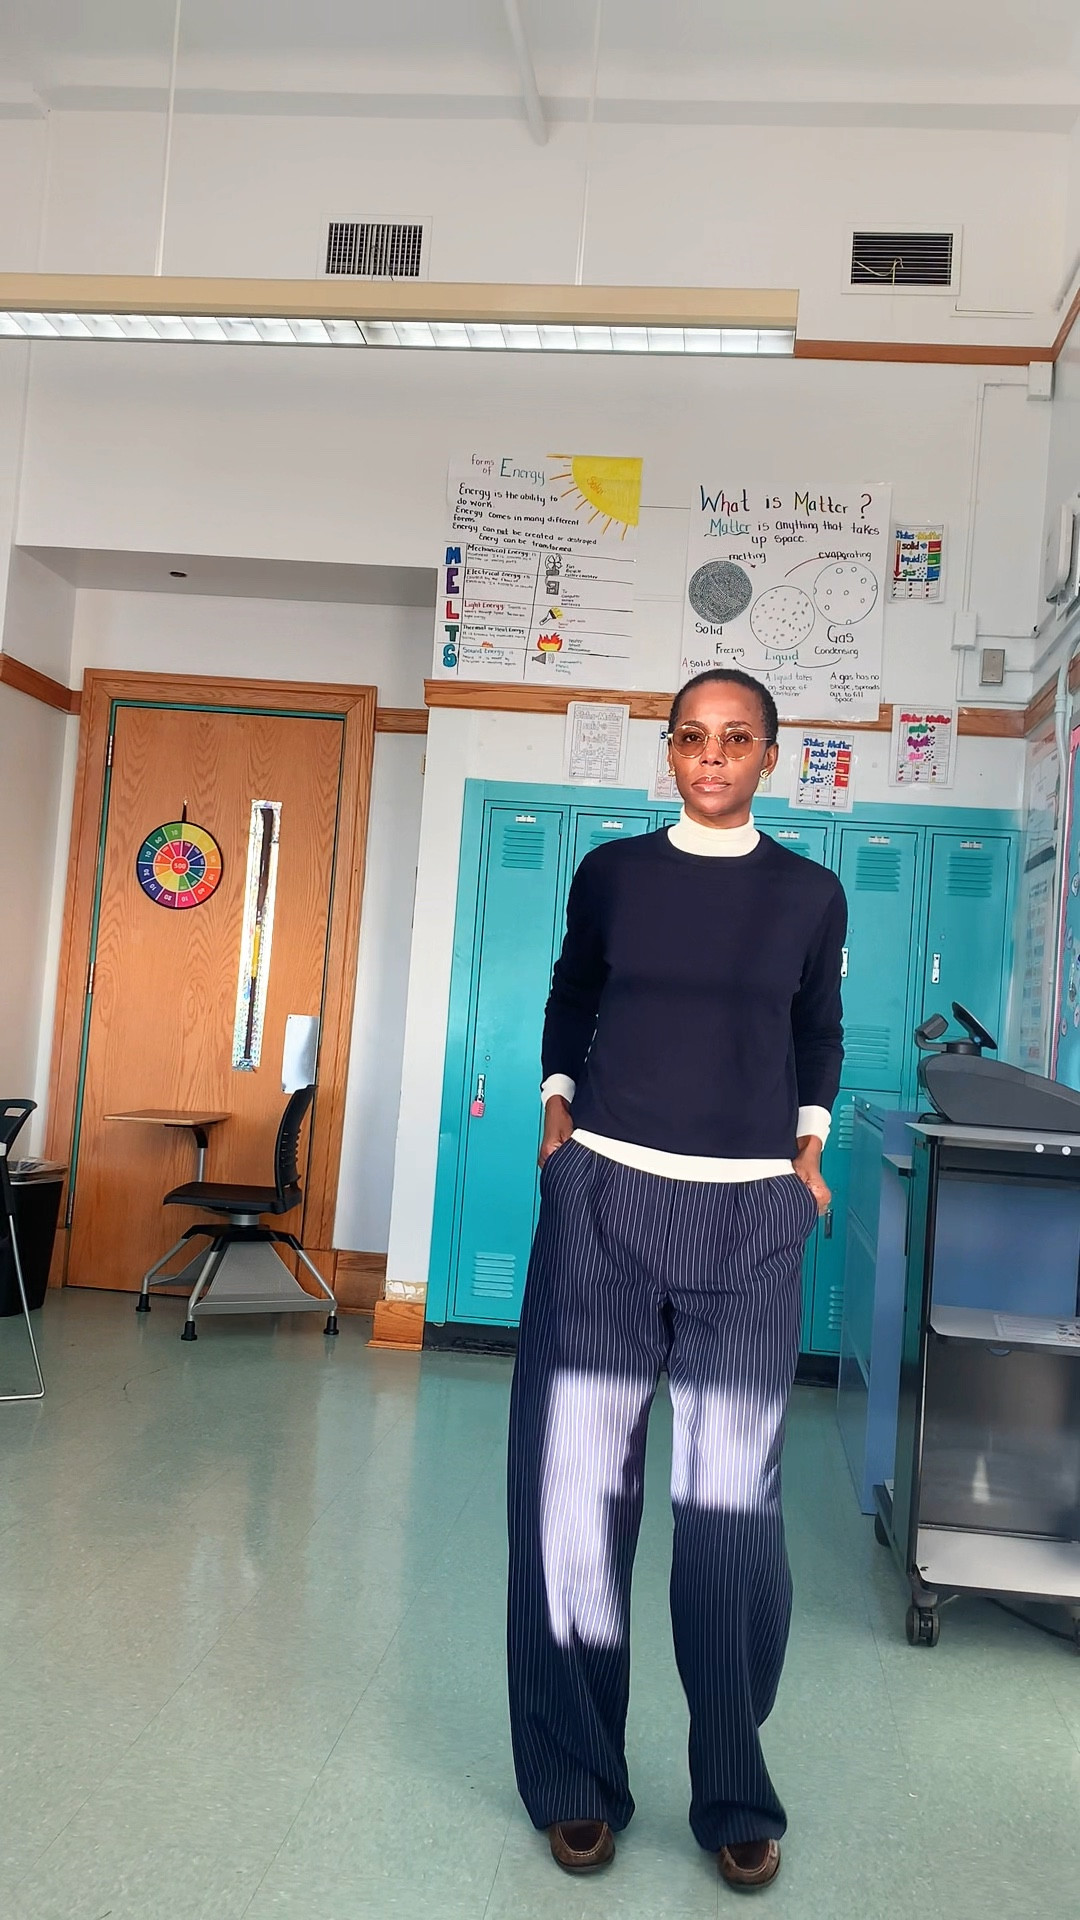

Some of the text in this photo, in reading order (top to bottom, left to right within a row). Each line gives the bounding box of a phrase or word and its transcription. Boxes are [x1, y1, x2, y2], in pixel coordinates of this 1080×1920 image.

[482, 466, 491, 475] of
[500, 458, 545, 485] Energy
[459, 482, 491, 500] Energy
[505, 491, 518, 499] the
[520, 493, 545, 506] ability
[700, 485, 750, 516] What
[765, 494, 782, 509] is
[794, 491, 848, 516] Matter
[457, 497, 467, 505] do
[455, 505, 483, 518] Energy
[523, 516, 545, 525] many
[547, 516, 579, 526] different
[709, 518, 880, 536] Matter is anything that takes
[452, 522, 478, 533] Energy
[524, 532, 553, 540] created
[567, 537, 597, 546] destroyed
[751, 535, 767, 548] up
[901, 541, 919, 550] solid
[467, 543, 506, 554] Mechanical
[507, 549, 529, 557] Energy
[818, 550, 872, 561] evaporating
[728, 551, 767, 563] melting
[900, 553, 920, 565] liquid
[466, 568, 500, 577] Electrical
[902, 569, 917, 577] gas
[464, 599, 481, 610] Light
[482, 601, 504, 611] Energy
[695, 622, 723, 636] Solid
[827, 625, 854, 644] Gas
[462, 647, 482, 655] Sound
[484, 648, 505, 658] Energy
[715, 643, 745, 657] Freezing
[814, 646, 859, 659] Condensing
[681, 657, 688, 668] A
[765, 650, 799, 665] Liquid
[765, 671, 813, 684] A liquid takes
[830, 671, 837, 680] A
[839, 674, 853, 684] gas
[856, 672, 868, 680] has
[810, 748, 829, 758] solid
[809, 761, 829, 772] liquid
[810, 776, 824, 784] gas
